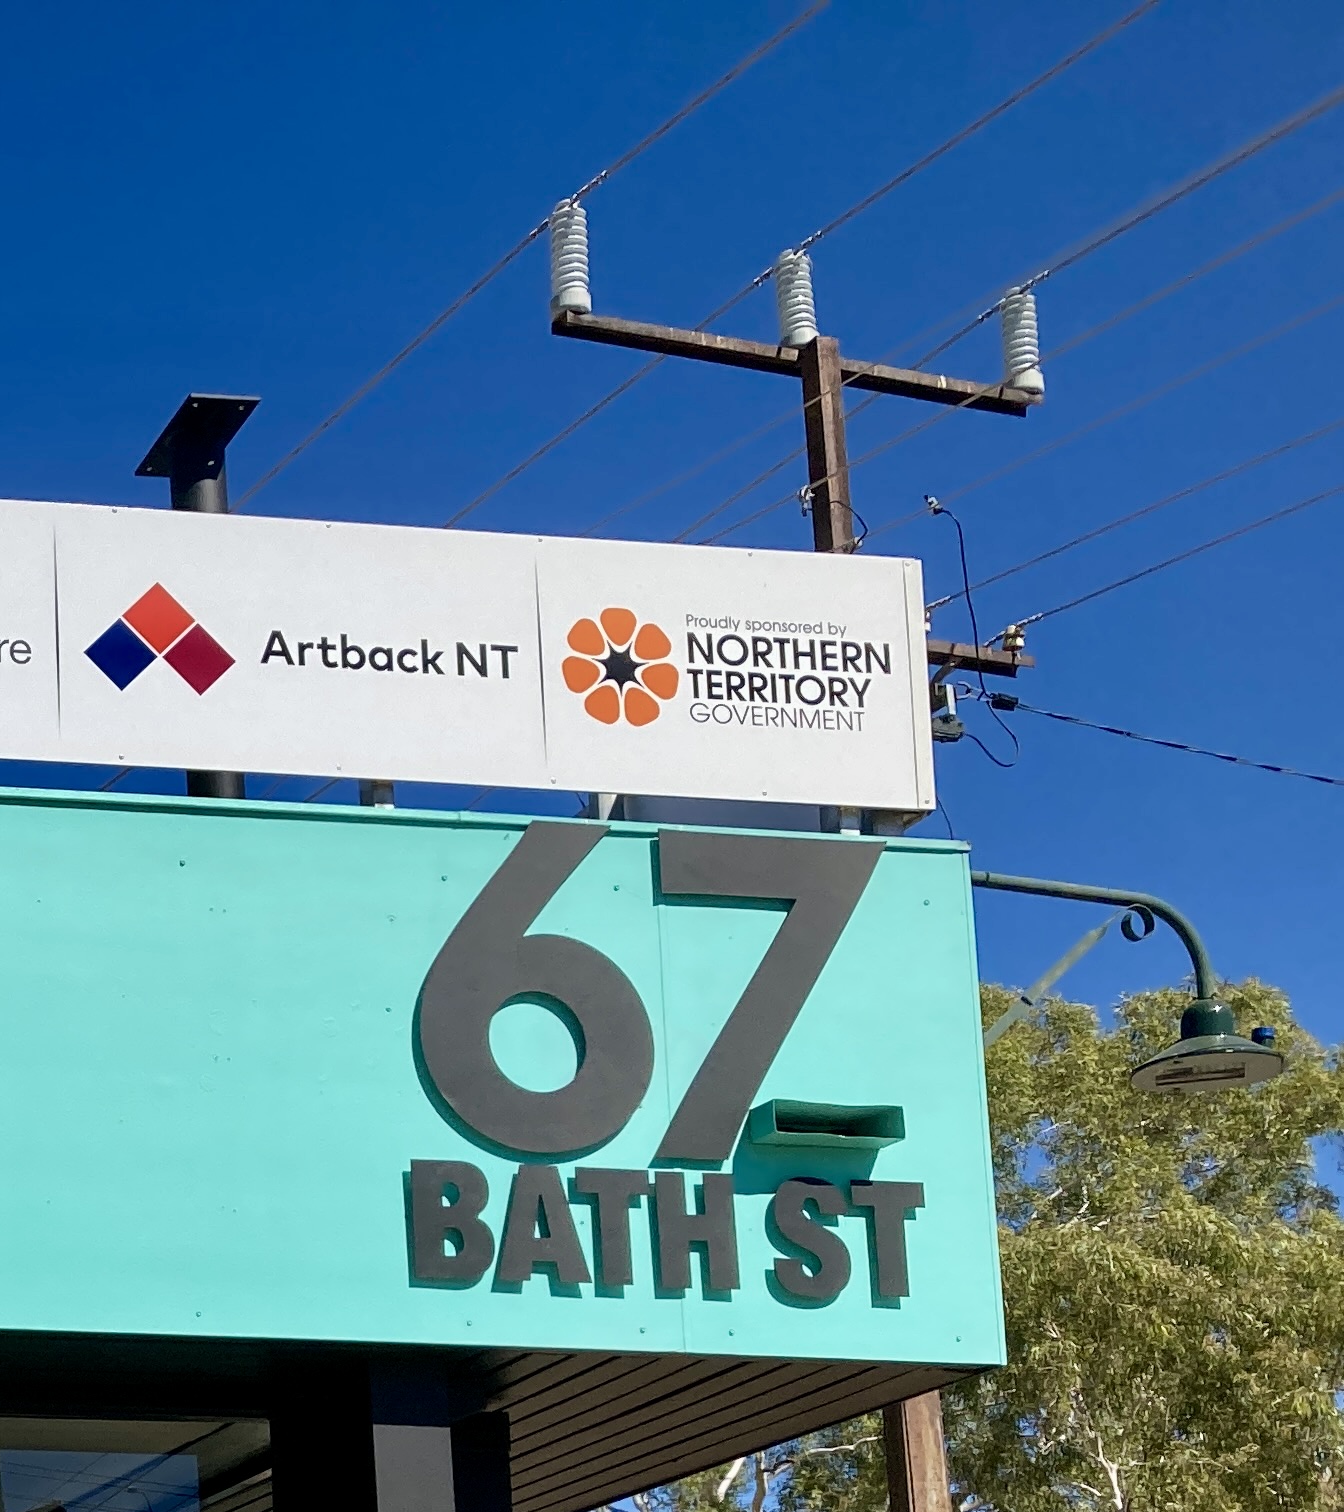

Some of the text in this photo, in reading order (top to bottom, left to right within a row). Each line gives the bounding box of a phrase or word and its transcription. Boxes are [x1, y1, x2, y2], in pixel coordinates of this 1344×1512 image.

[684, 612, 848, 639] Proudly sponsored by
[259, 629, 519, 680] Artback NT
[686, 632, 892, 676] NORTHERN
[688, 668, 872, 710] TERRITORY
[689, 702, 865, 733] GOVERNMENT
[415, 820, 887, 1164] 67
[408, 1158, 926, 1304] BATH ST
